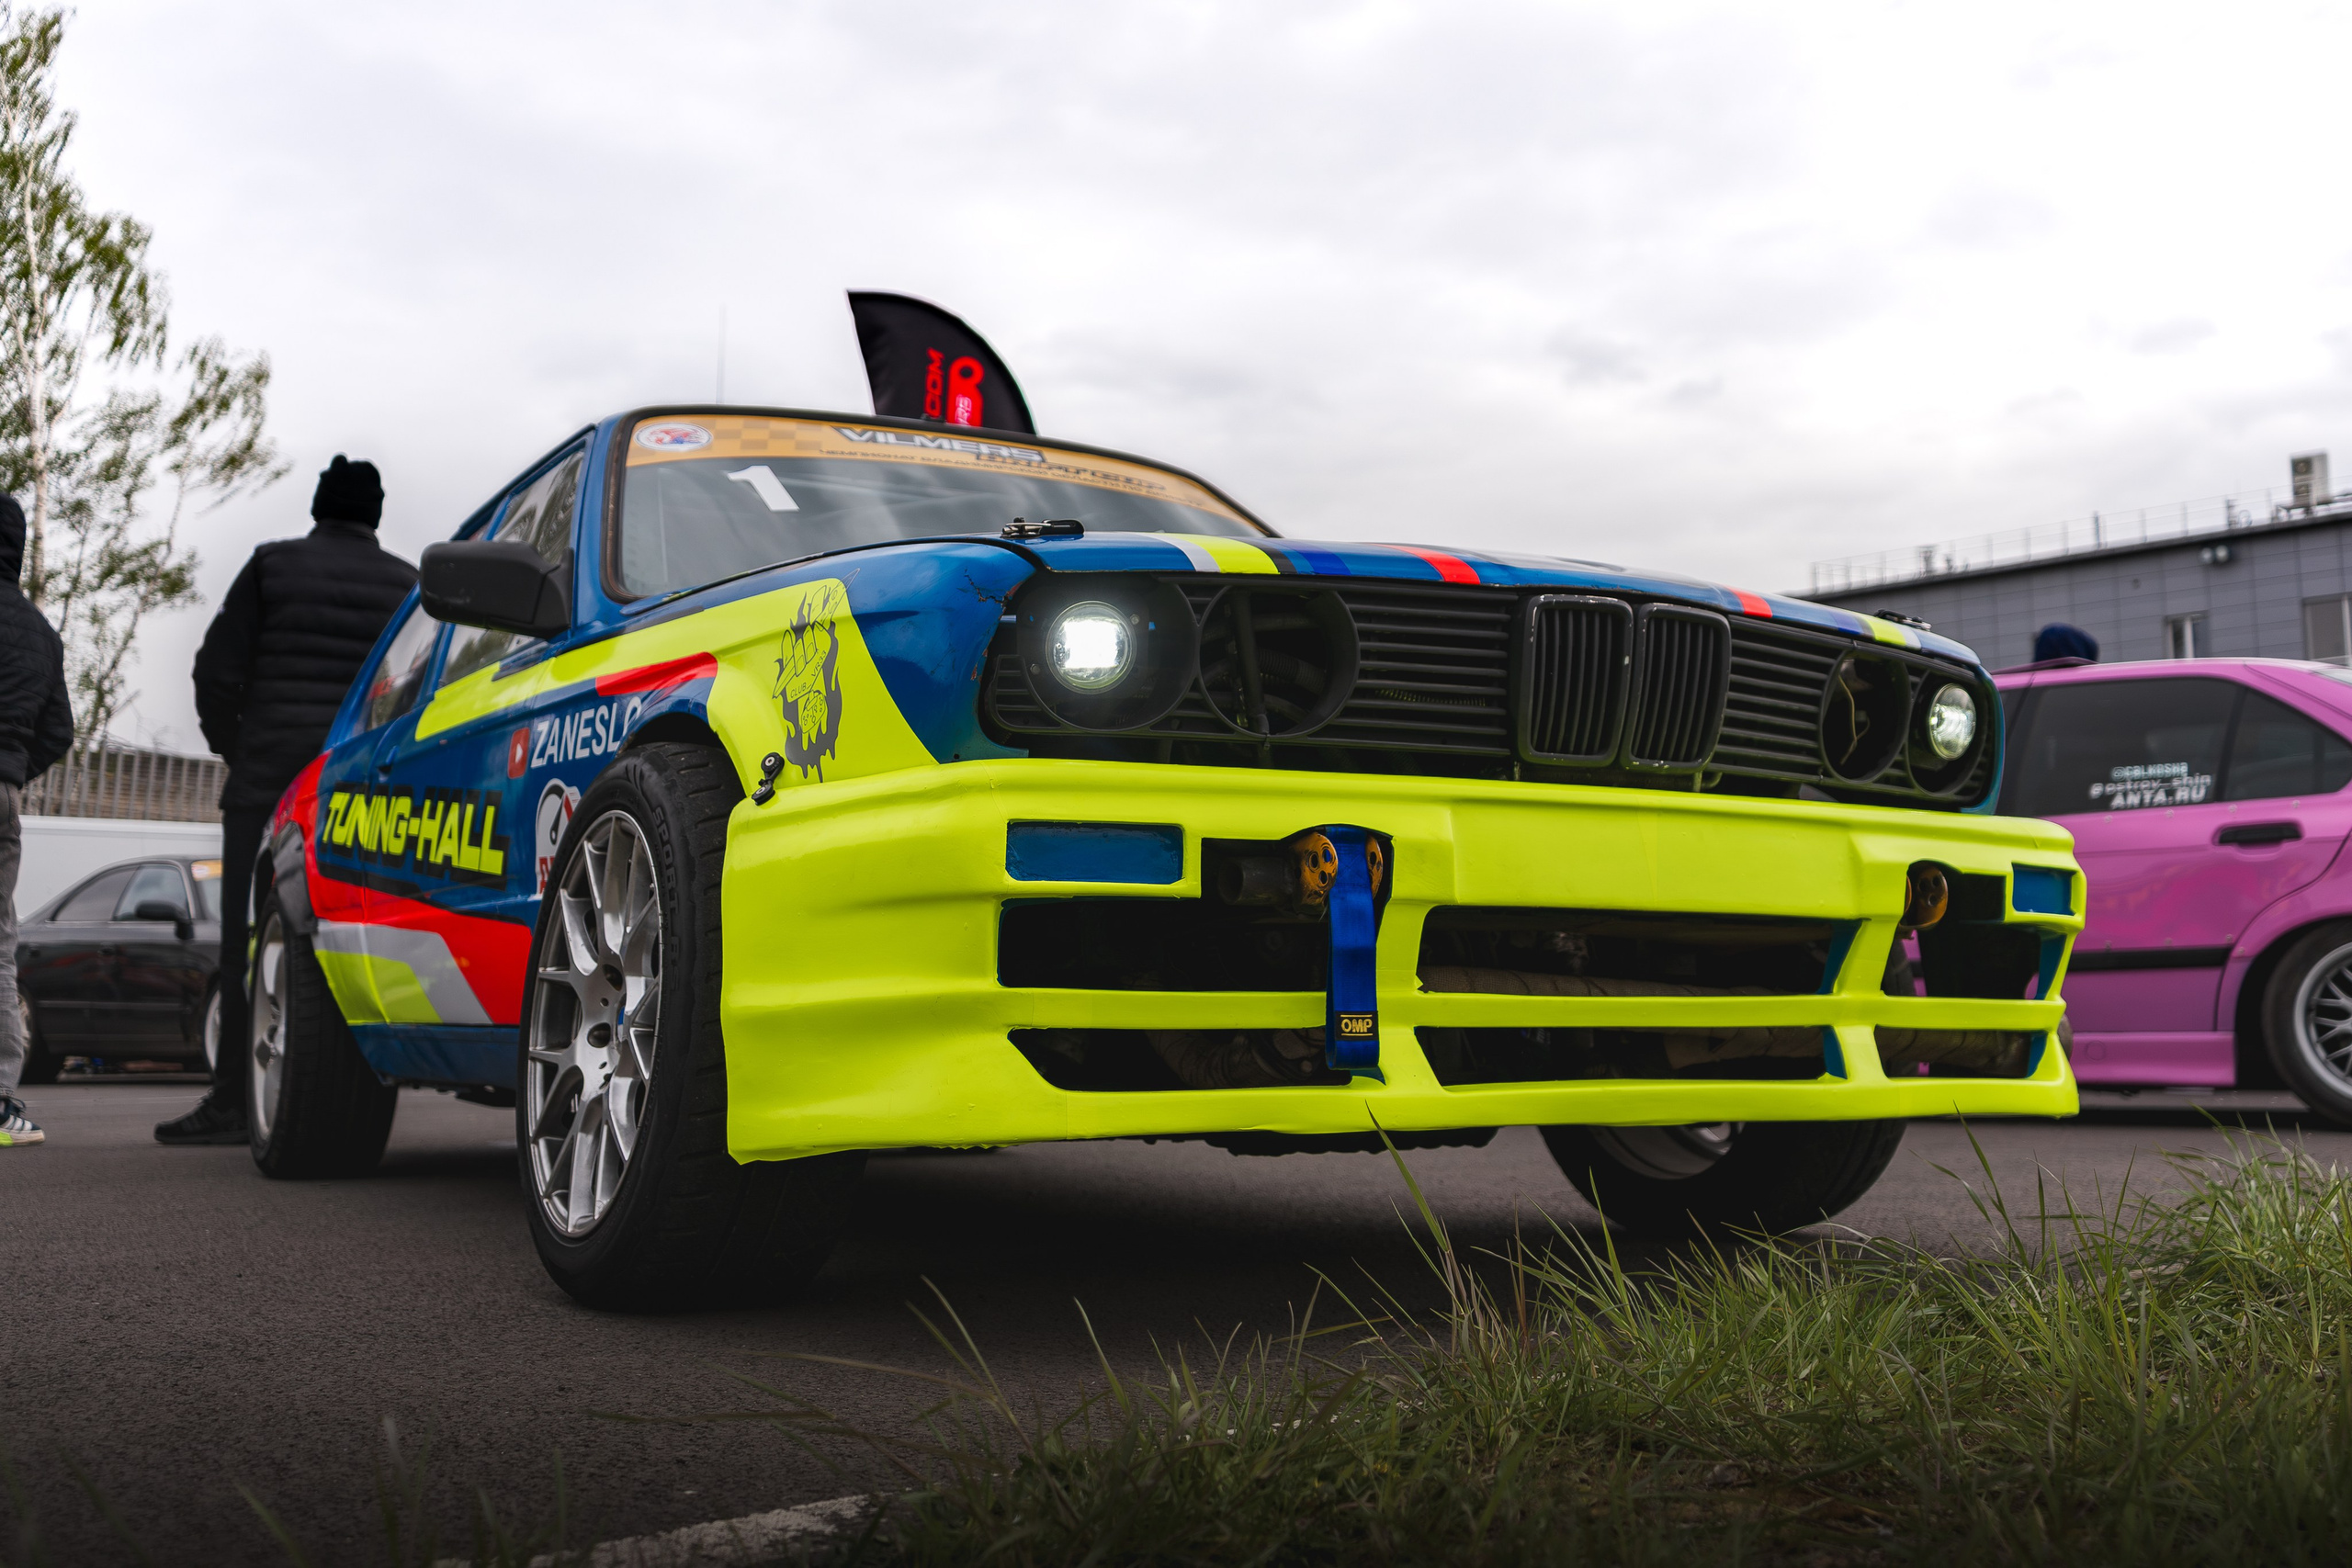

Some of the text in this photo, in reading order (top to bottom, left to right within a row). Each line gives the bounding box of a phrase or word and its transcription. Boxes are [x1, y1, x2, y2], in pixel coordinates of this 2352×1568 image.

[833, 427, 1045, 463] VILMERS
[727, 465, 799, 513] 1
[2109, 785, 2207, 809] ANTA.RU
[322, 791, 504, 876] TUNING-HALL
[652, 807, 679, 914] SPORT
[1341, 1019, 1373, 1033] OMP
